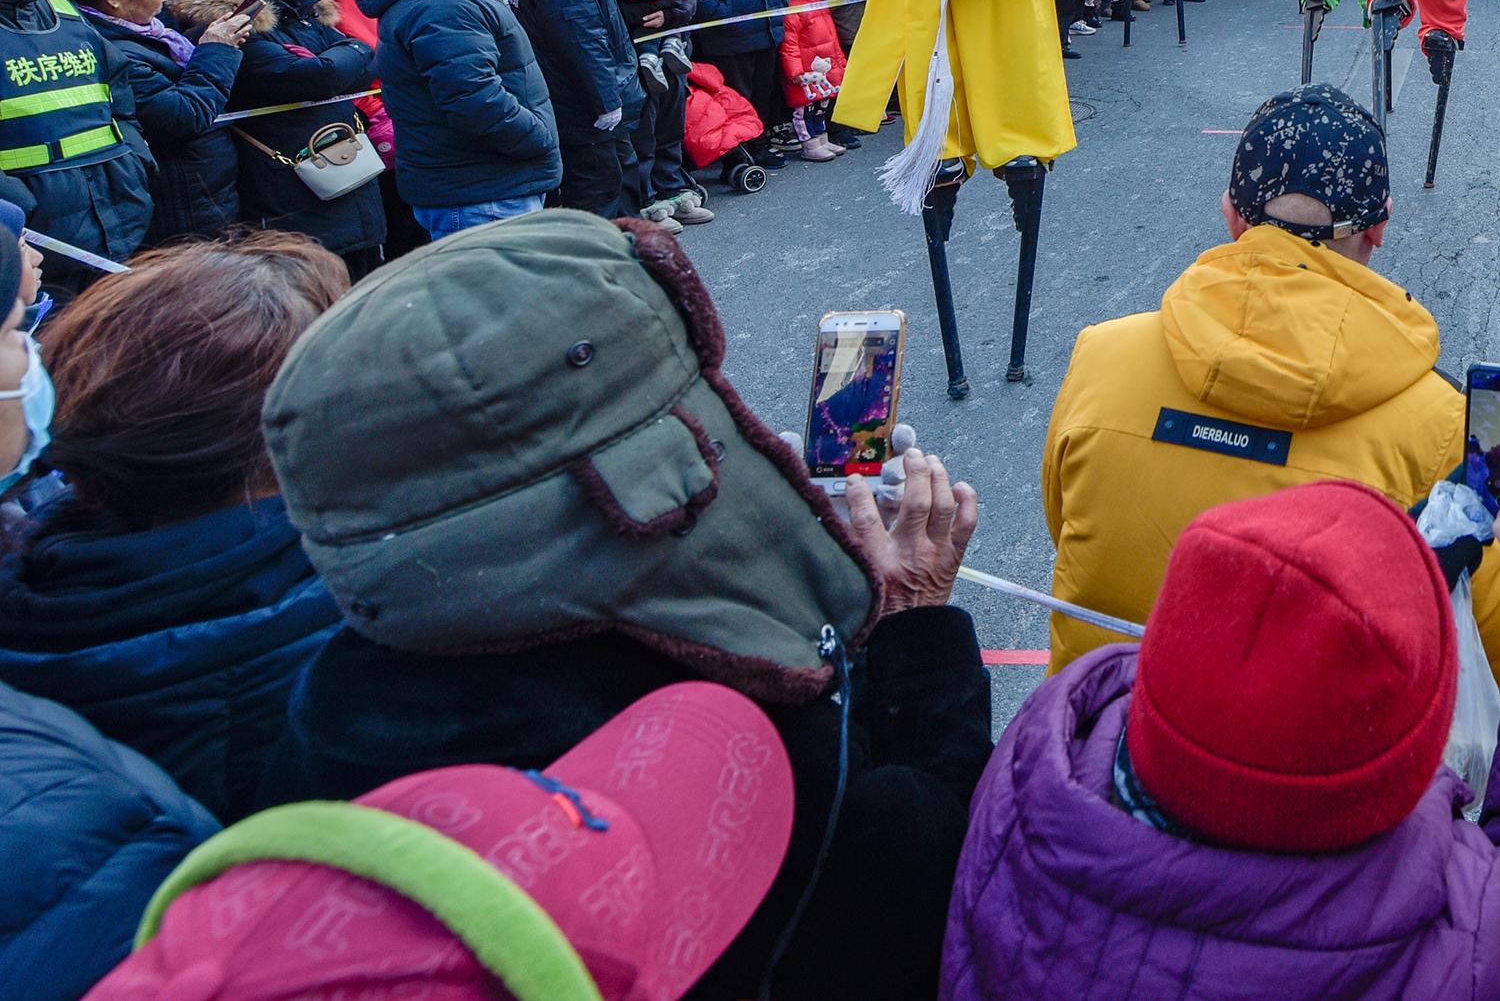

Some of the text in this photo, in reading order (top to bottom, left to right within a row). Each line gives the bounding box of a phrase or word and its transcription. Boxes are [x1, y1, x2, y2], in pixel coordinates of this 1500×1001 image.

[4, 48, 98, 87] 秩序维护
[1191, 424, 1250, 449] DIERBALUO
